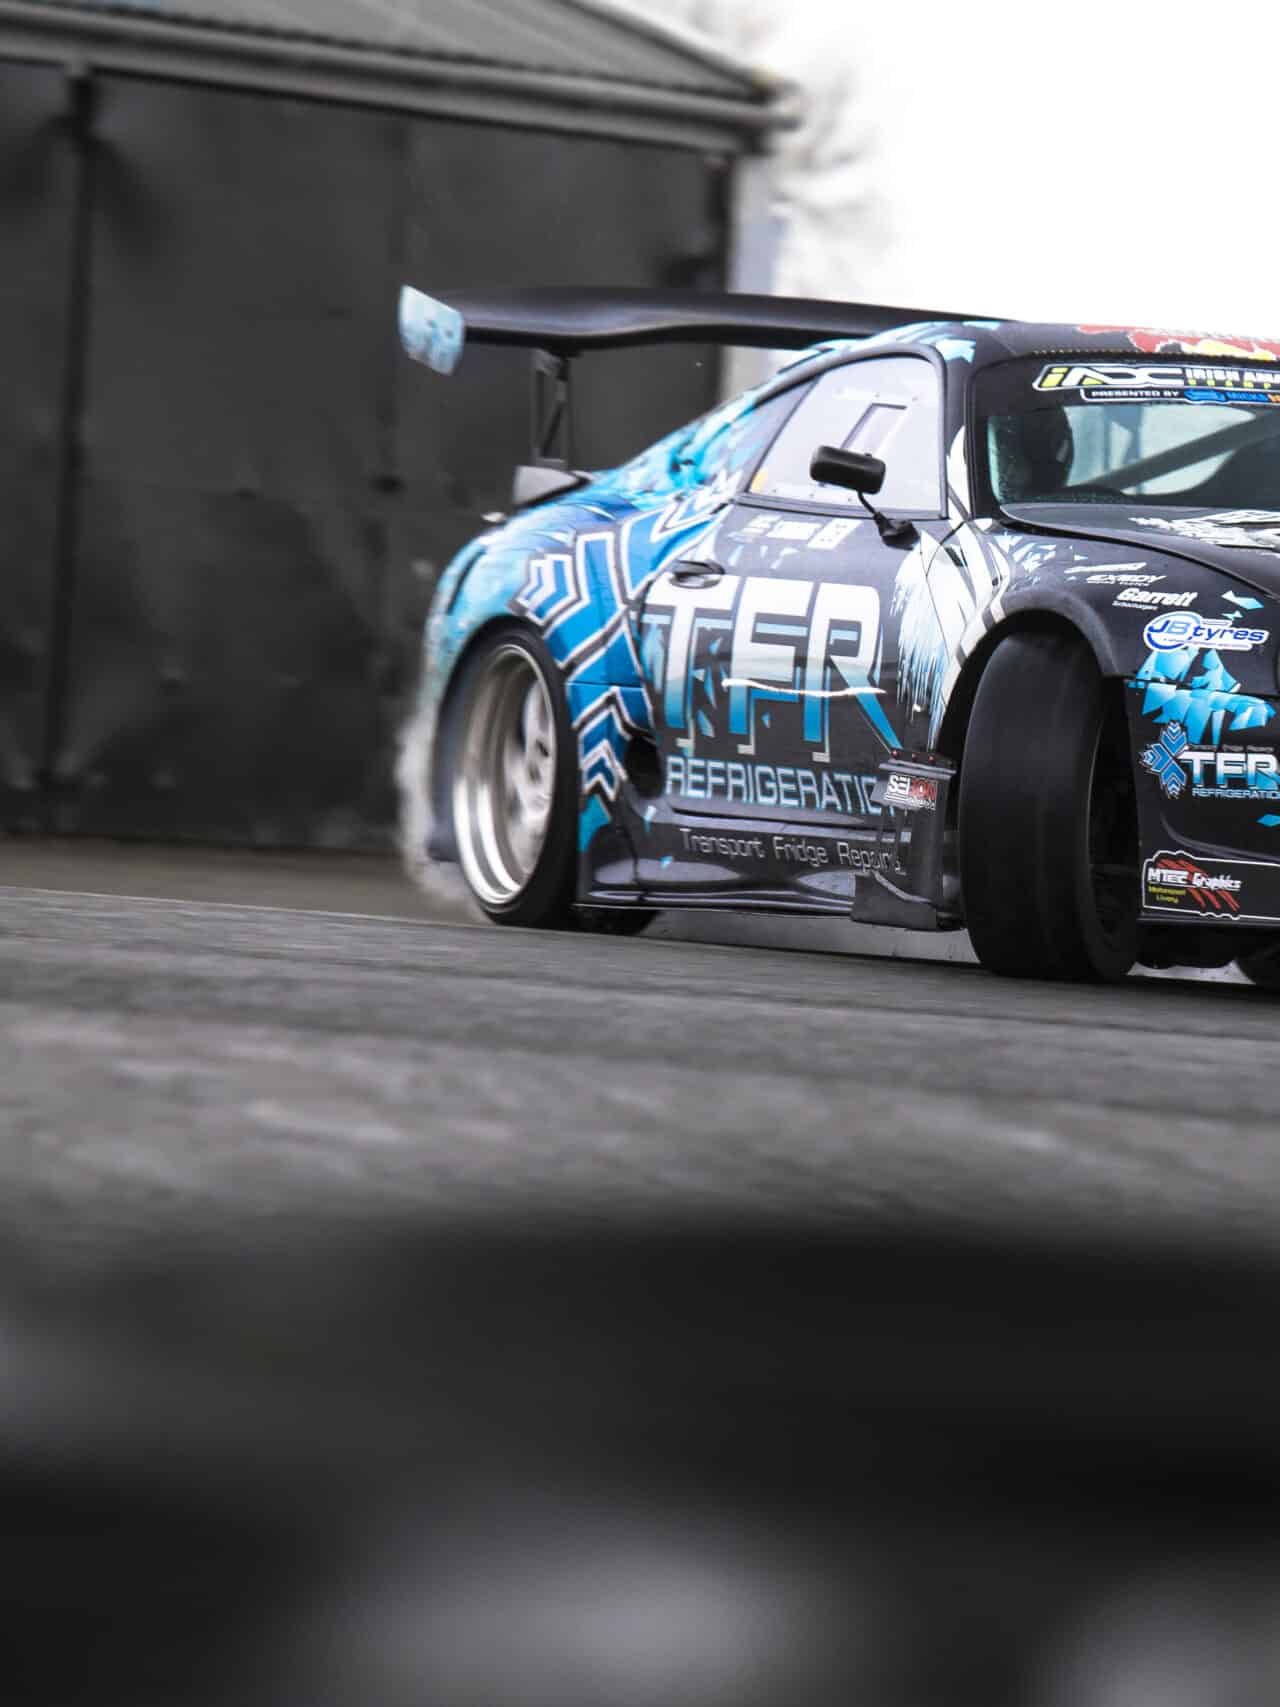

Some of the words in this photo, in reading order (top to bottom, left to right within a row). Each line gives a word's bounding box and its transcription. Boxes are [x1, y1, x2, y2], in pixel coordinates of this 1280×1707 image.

[1185, 367, 1241, 382] IRISH
[644, 571, 904, 756] TFR
[680, 828, 765, 860] Transport
[772, 835, 829, 868] Fridge
